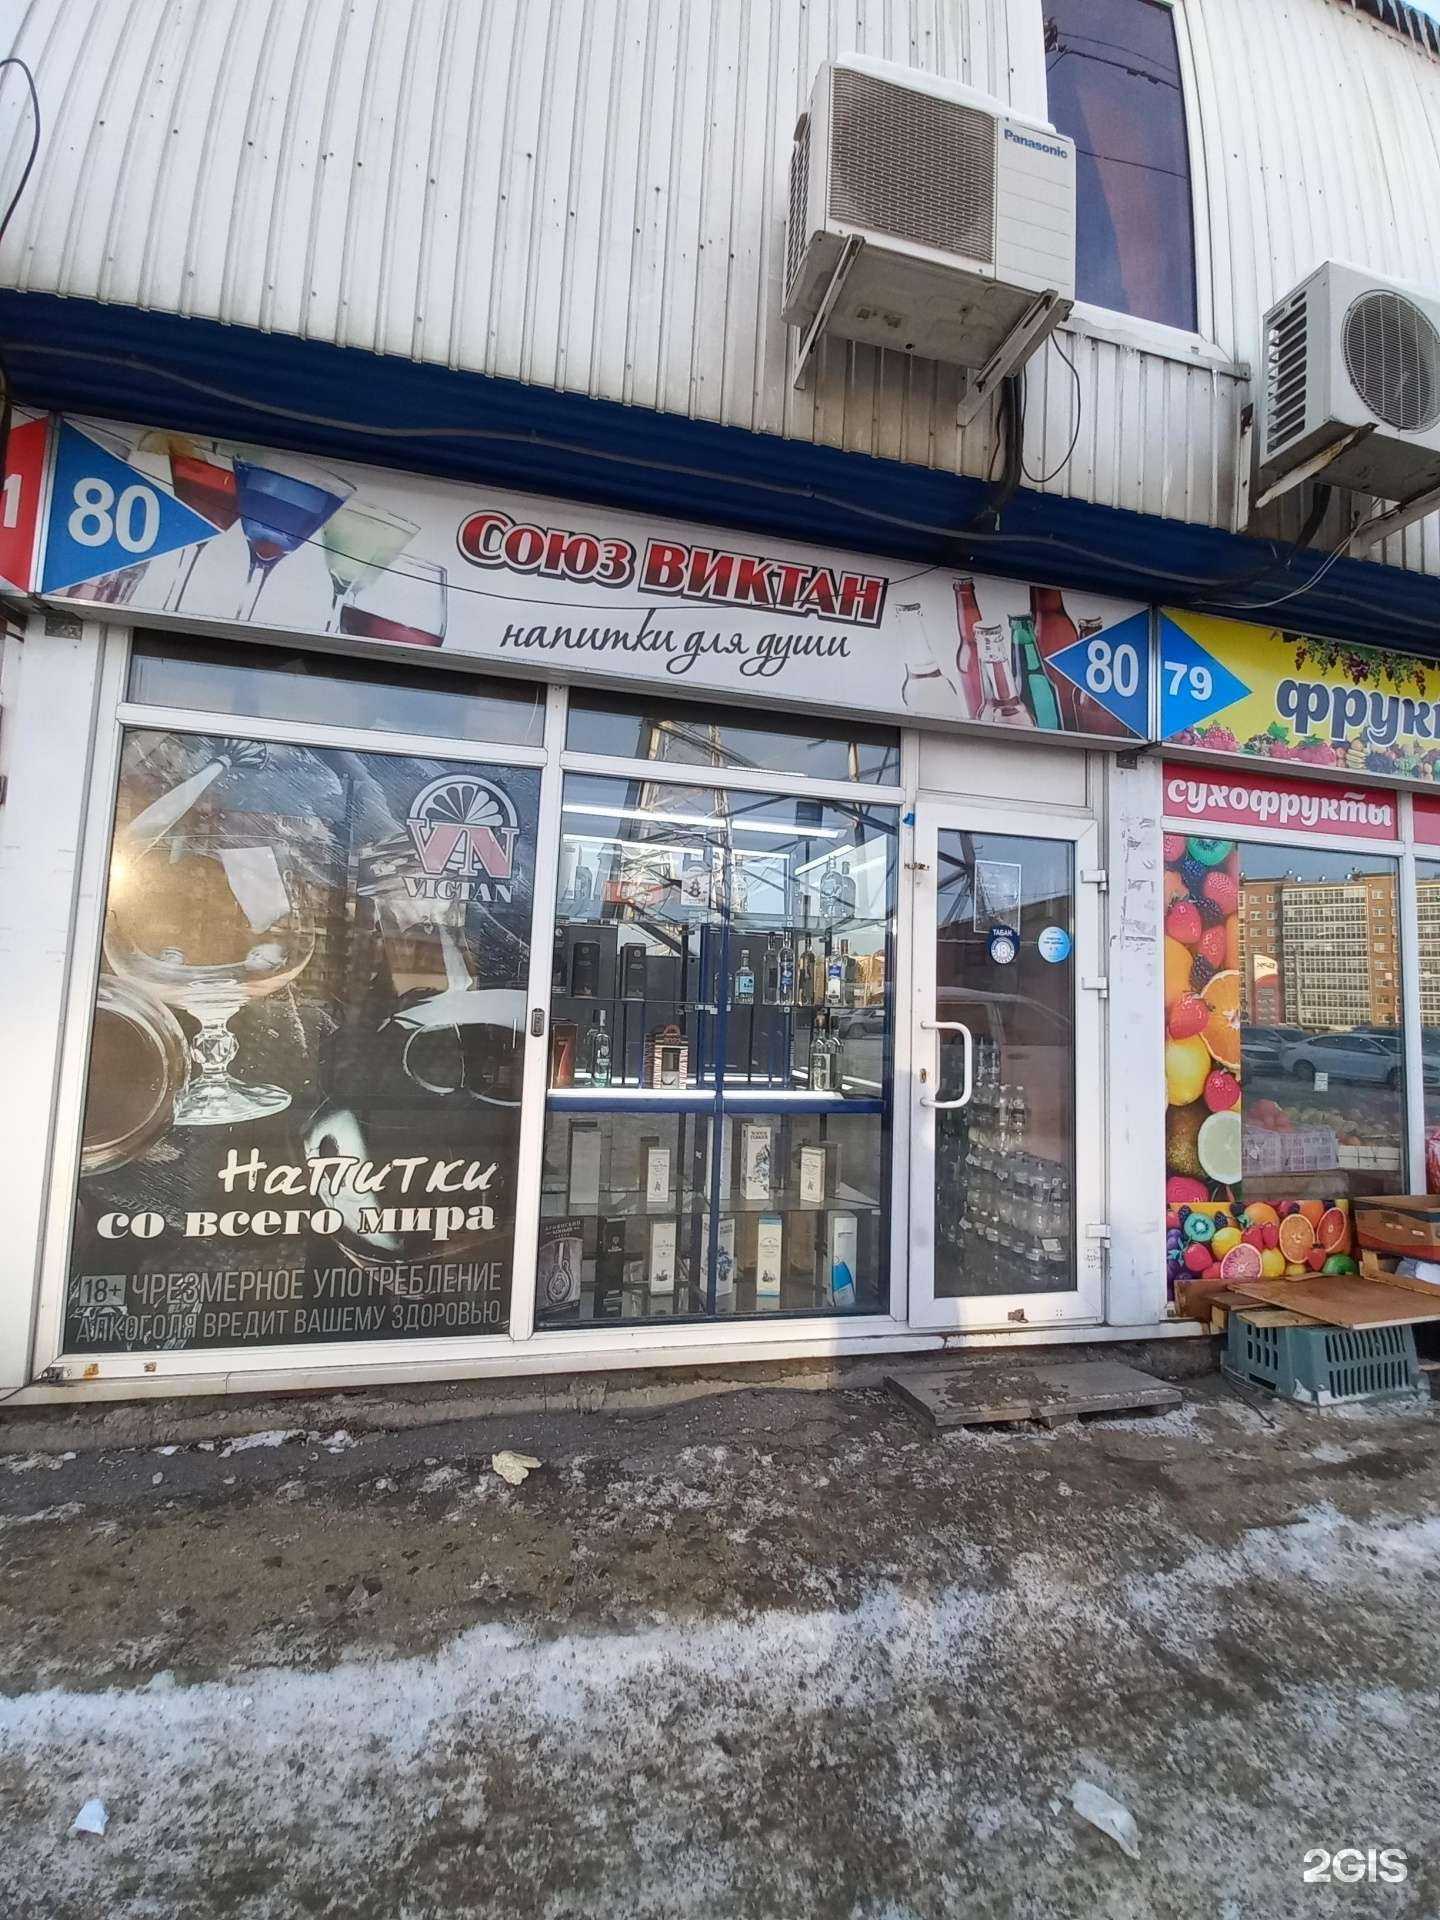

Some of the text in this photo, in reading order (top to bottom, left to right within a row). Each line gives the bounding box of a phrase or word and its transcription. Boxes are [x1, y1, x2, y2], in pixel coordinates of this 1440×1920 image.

[1004, 128, 1069, 160] Panasonic
[68, 477, 161, 553] 80
[638, 538, 889, 629] ВИКТАН
[499, 608, 851, 677] напитки для души
[1086, 640, 1139, 697] 80
[1164, 661, 1213, 700] 79
[1275, 678, 1440, 746] фрук
[1167, 778, 1393, 827] сухофрукты
[402, 876, 514, 904] VICTAN
[992, 928, 1013, 937] ТАБАК
[96, 1203, 496, 1242] со всего мира
[83, 1262, 503, 1305] 18+ ЧРЕЗМЕРНОЕ УПОТРЕБЛЕНИЕ
[76, 1299, 501, 1343] АЛКОГОЛЯ ВРЕДИТ ВАШЕМУ ЗДОРОВЬЮ
